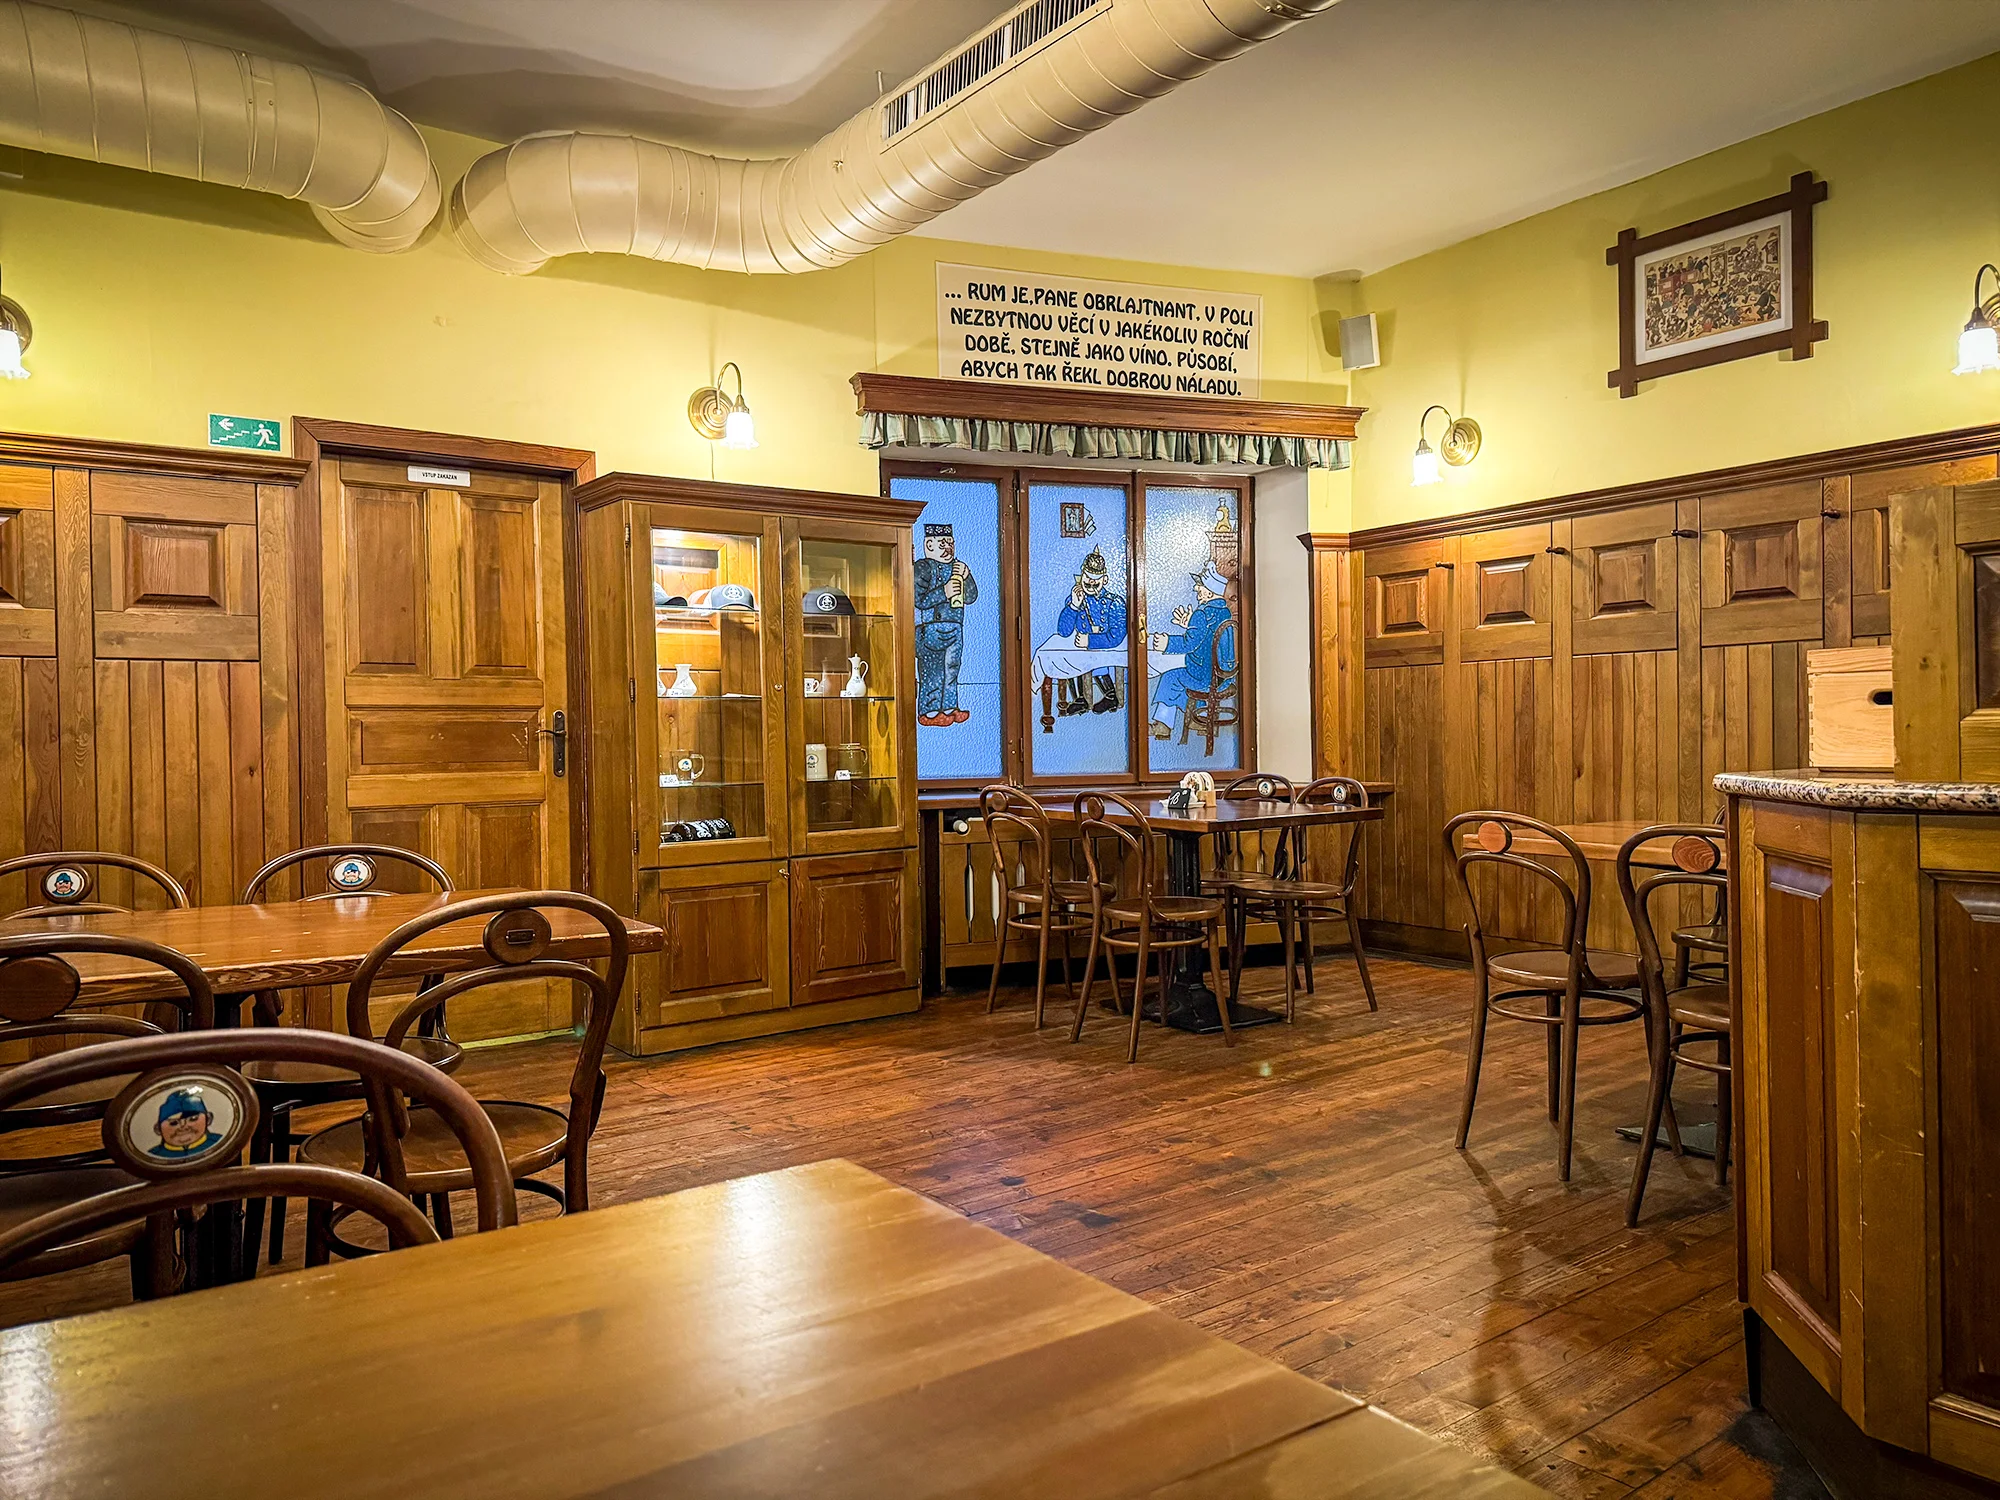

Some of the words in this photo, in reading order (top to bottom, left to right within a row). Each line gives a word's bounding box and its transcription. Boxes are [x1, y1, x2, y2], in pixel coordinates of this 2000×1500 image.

[967, 282, 1005, 302] RUM
[1204, 305, 1216, 323] V
[1220, 307, 1253, 327] POLI
[950, 307, 1053, 331] NEZBYTNOU
[1057, 312, 1094, 335] VĚCÍ
[1099, 318, 1110, 337] V
[1114, 320, 1198, 345] JAKÉKOLIV
[1202, 327, 1251, 350] ROČNÍ
[964, 331, 1016, 355] DOBĚ,
[1020, 337, 1081, 359] STEJNĚ
[1084, 342, 1125, 363] JAKO
[1129, 343, 1172, 367] VÍNO.
[1177, 347, 1237, 374] PŮSOBÍ,
[960, 359, 1019, 379] ABYCH
[1023, 362, 1057, 381] TAK
[1061, 360, 1102, 385] ŘEKL
[1106, 369, 1172, 391] DOBROU
[1176, 372, 1242, 397] NÁLADU.
